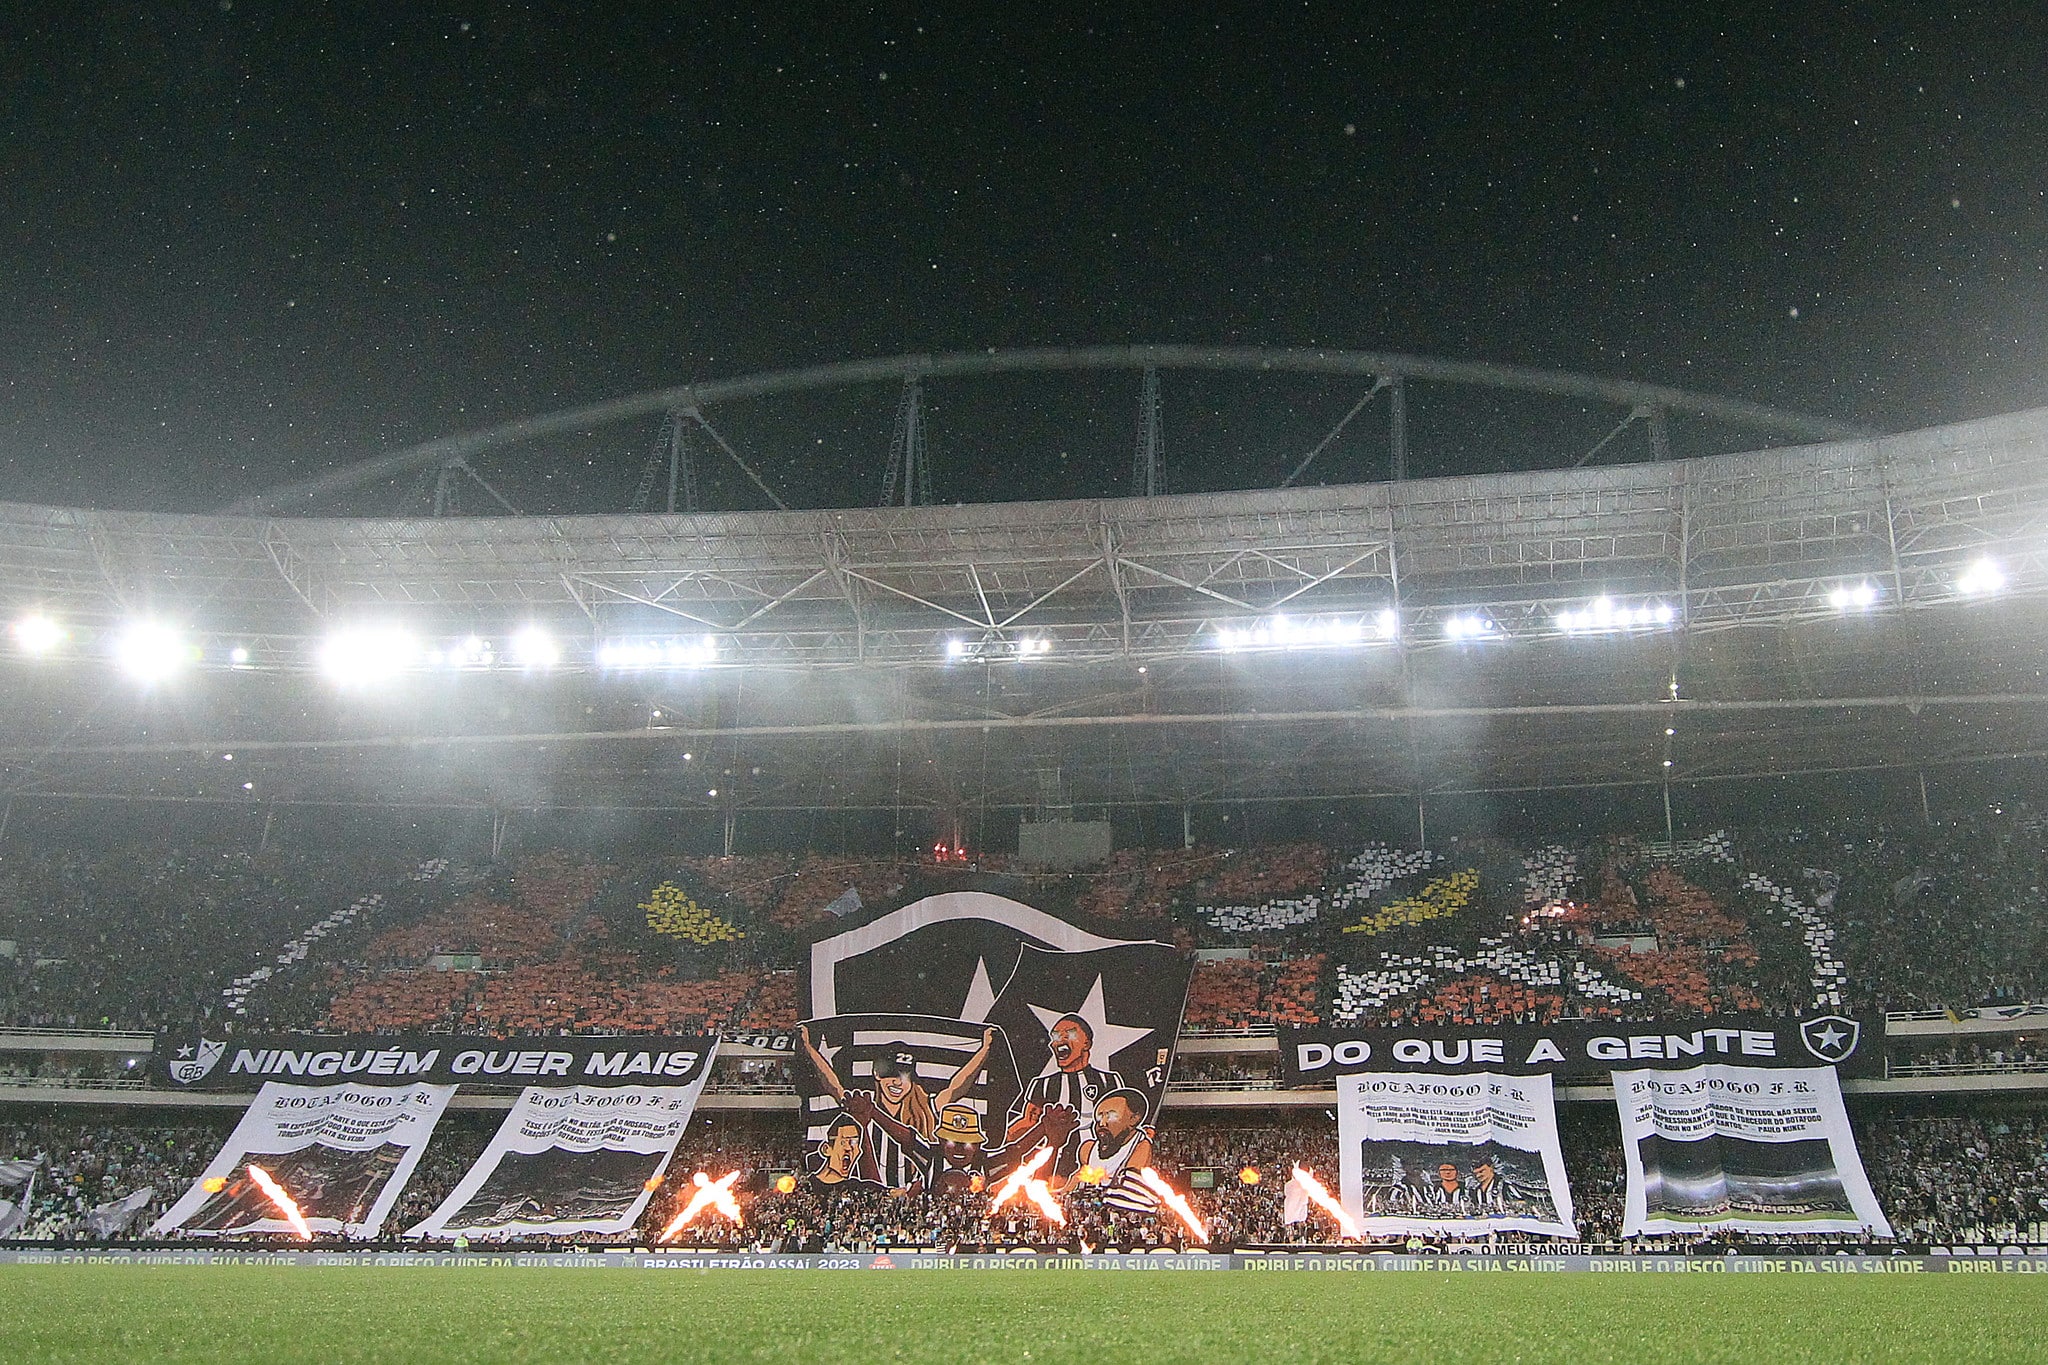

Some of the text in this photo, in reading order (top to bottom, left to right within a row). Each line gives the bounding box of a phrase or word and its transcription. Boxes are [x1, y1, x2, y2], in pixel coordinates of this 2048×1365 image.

[1297, 1028, 1776, 1072] DO QUE A GENTE
[229, 1045, 699, 1077] NINGUÉM QUER MAIS
[896, 1053, 913, 1064] 22
[1357, 1081, 1481, 1097] BOTAFOGO
[1631, 1078, 1760, 1096] BOTAFOGO
[529, 1092, 642, 1109] BOTAFOGO
[1691, 1107, 1702, 1115] UM
[1746, 1109, 1776, 1117] FUTEBOL
[1777, 1108, 1791, 1117] NÃO
[330, 1113, 349, 1124] PARTE
[1737, 1115, 1773, 1125] TORCEDOR
[1774, 1118, 1784, 1126] DO
[1785, 1115, 1822, 1125] BOTAFOGO
[342, 1125, 363, 1135] NESSA
[1758, 1126, 1782, 1134] PAULO
[1481, 1244, 1589, 1256] O MEU SANGUE
[644, 1256, 860, 1269] BRASILEIRÃO ASSAÍ 2023
[1044, 1258, 1094, 1270] CUIDE
[1099, 1258, 1121, 1270] DA
[1126, 1258, 1159, 1270] SUA
[1383, 1259, 1433, 1271] CUIDE
[1438, 1259, 1462, 1271] DA
[1467, 1259, 1502, 1271] SUA
[1734, 1260, 1786, 1273] CUIDE
[1791, 1260, 1816, 1273] DA
[1821, 1260, 1858, 1273] SUA
[1948, 1260, 2013, 1273] DRIBLE
[2017, 1260, 2032, 1273] O
